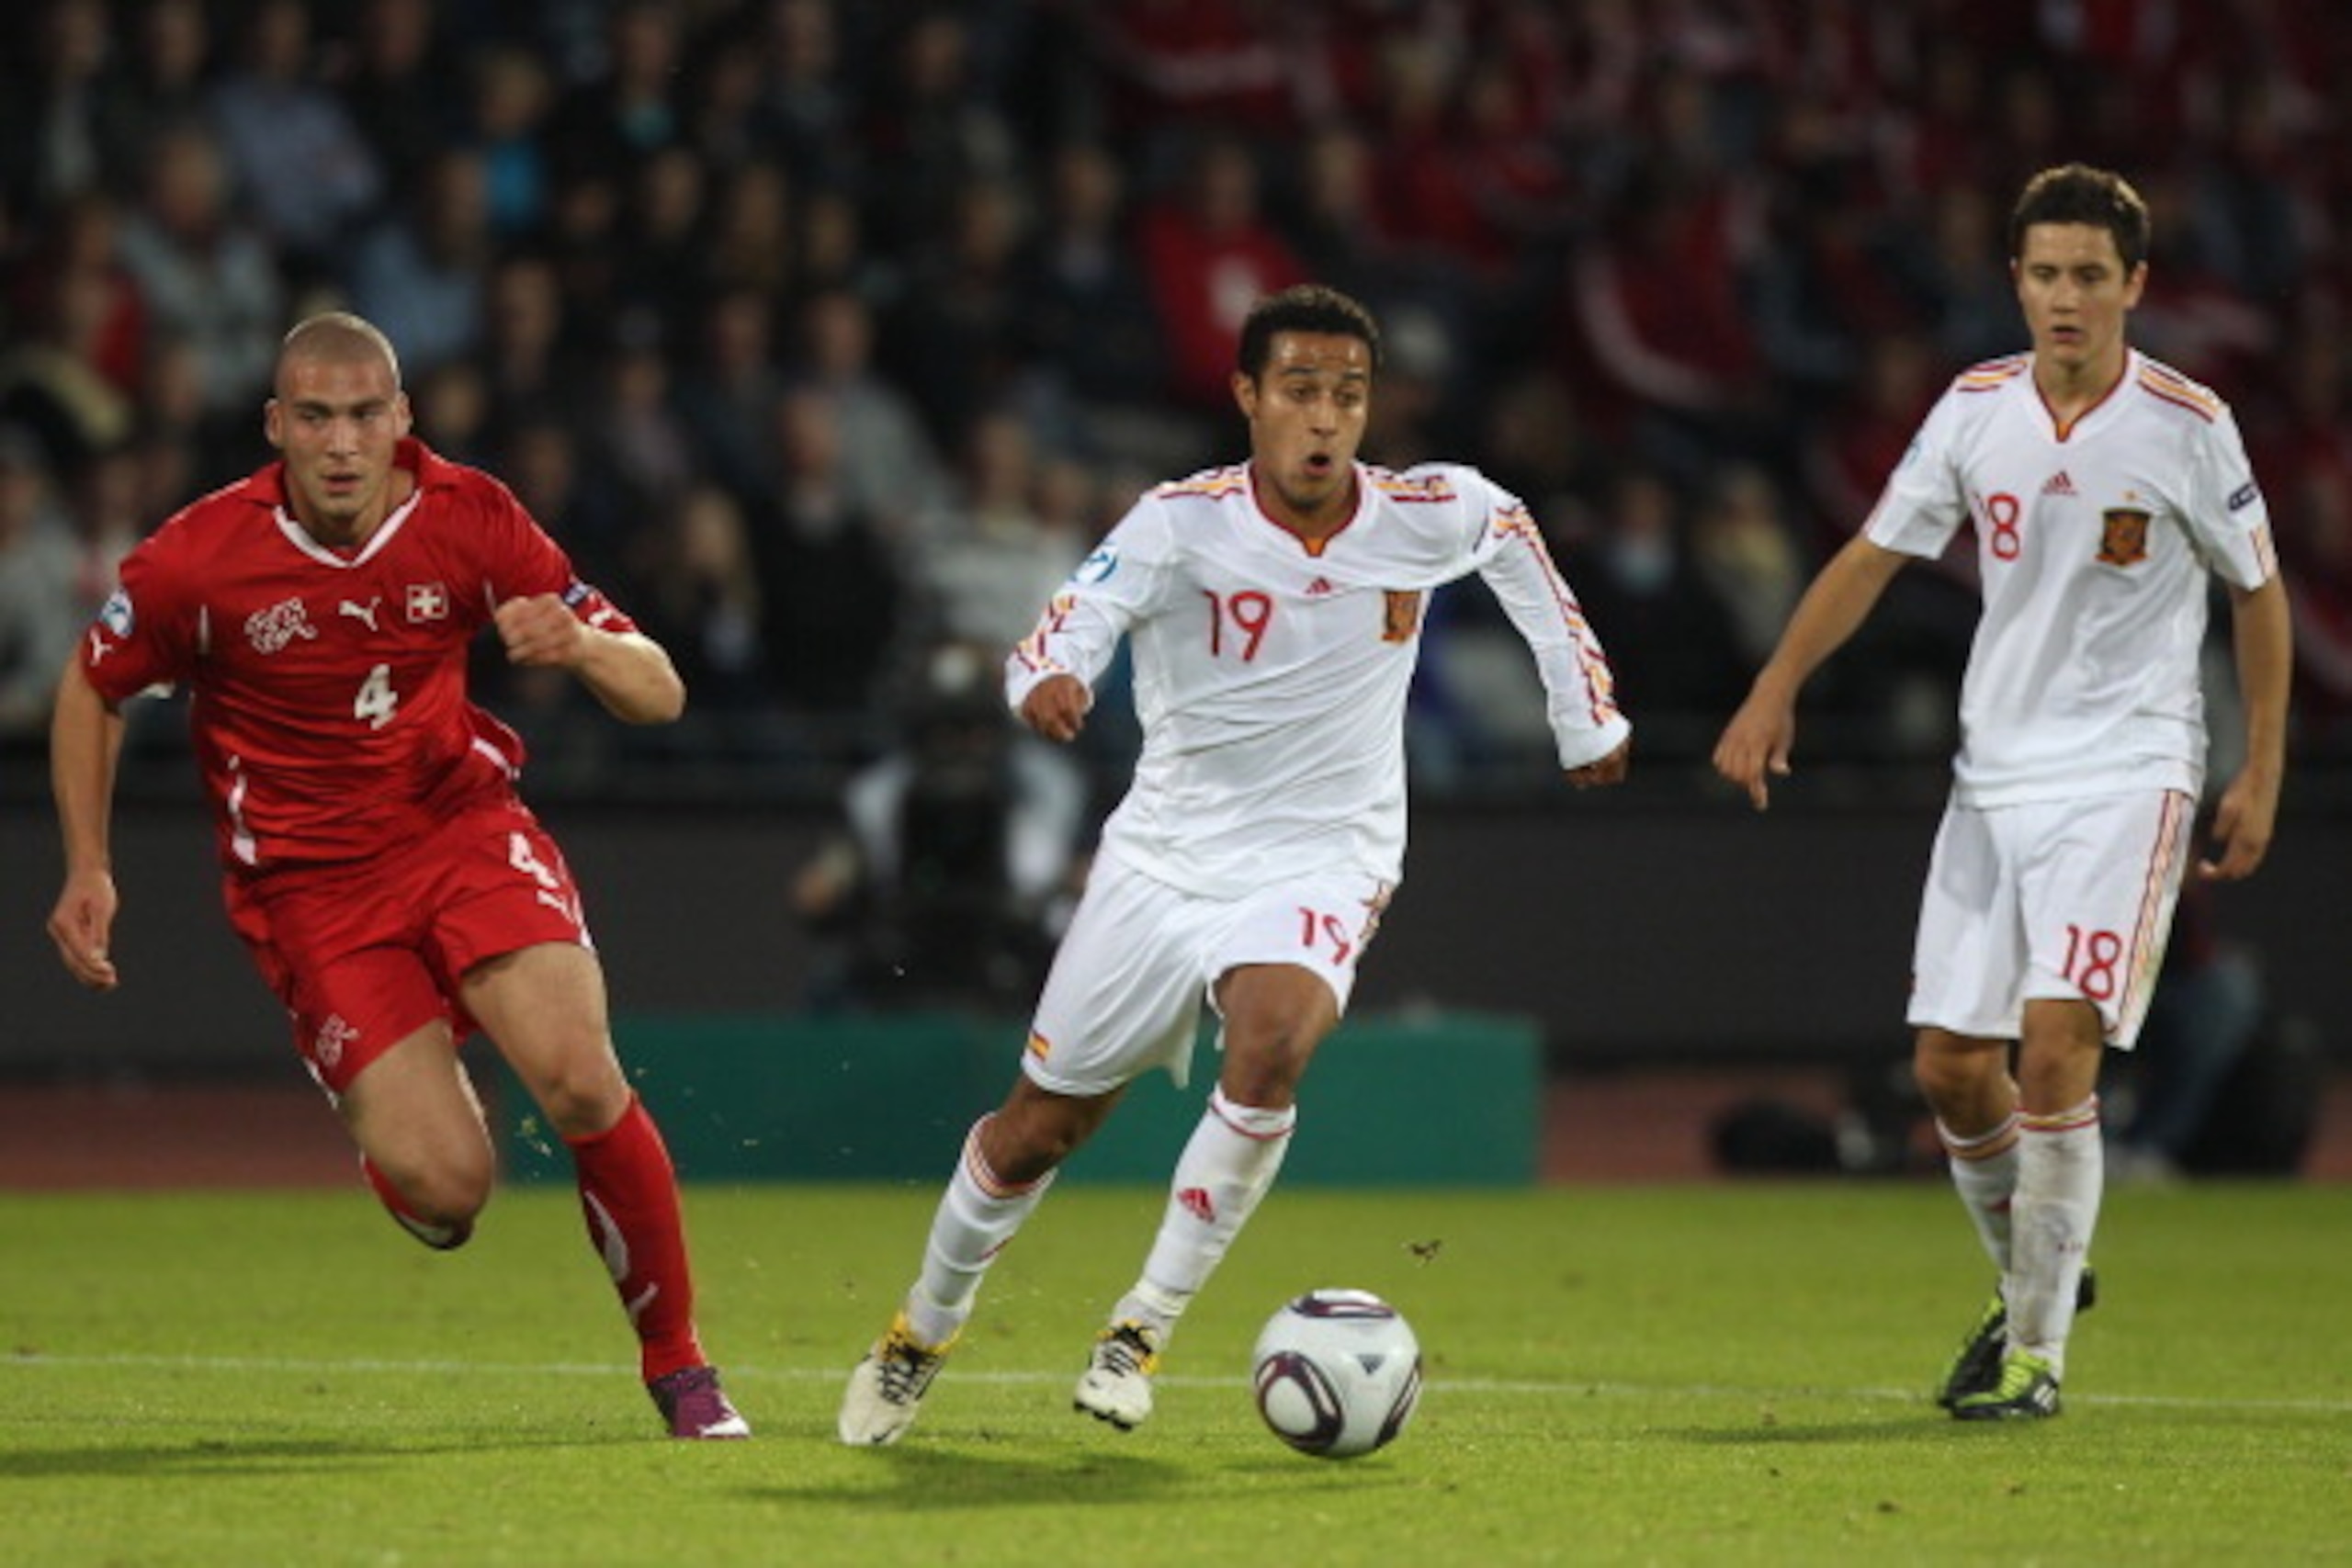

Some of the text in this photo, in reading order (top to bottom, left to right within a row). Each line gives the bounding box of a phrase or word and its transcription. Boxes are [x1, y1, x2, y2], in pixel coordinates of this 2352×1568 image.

[1202, 590, 1271, 661] 19
[354, 662, 398, 730] 4
[509, 831, 560, 888] 4
[1298, 907, 1351, 965] 19
[2063, 923, 2122, 1001] 18
